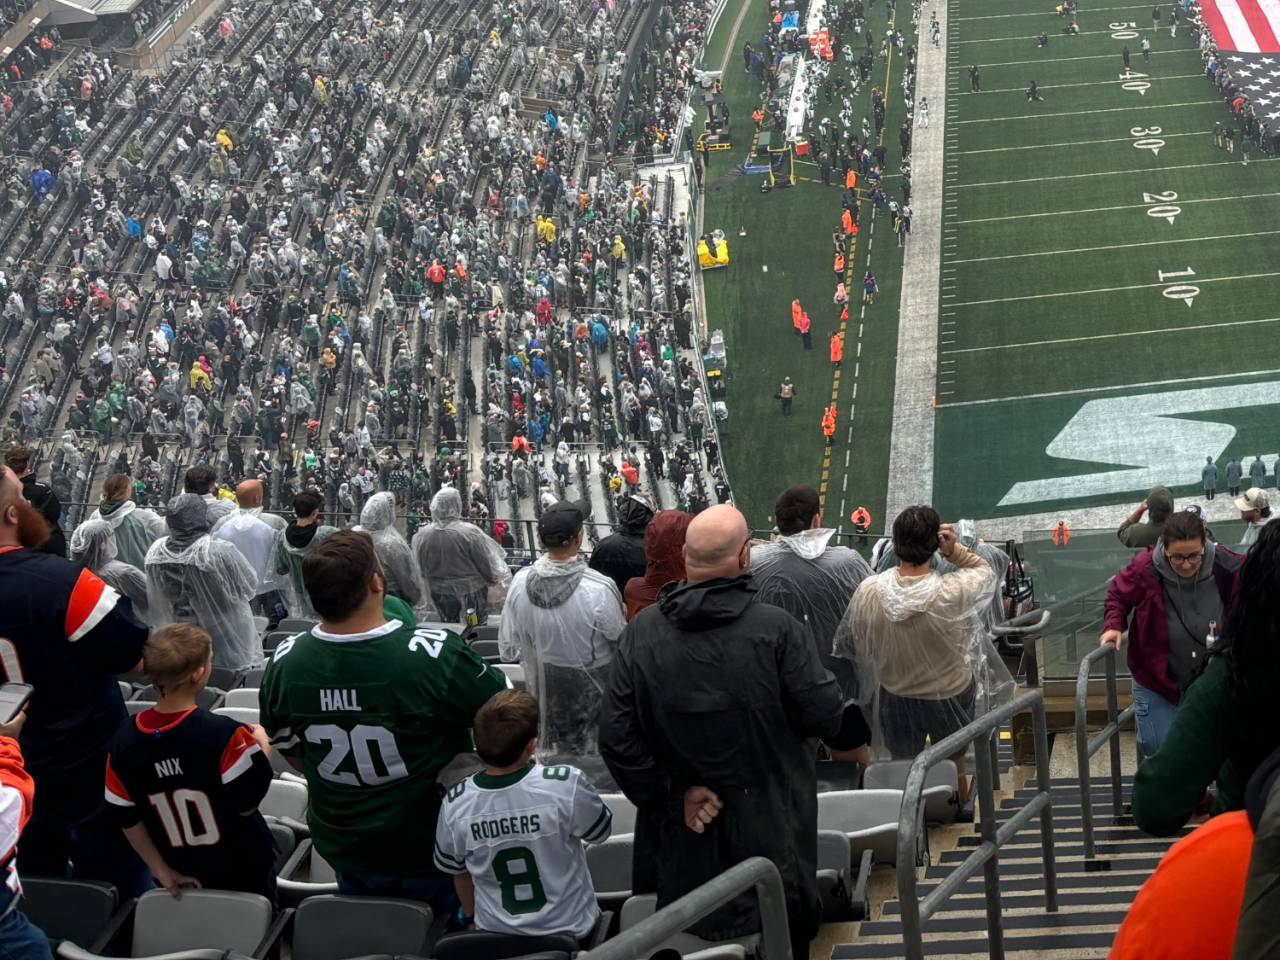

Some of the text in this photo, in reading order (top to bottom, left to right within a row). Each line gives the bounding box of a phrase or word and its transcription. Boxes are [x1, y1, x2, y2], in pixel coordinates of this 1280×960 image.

[1109, 21, 1139, 40] 50
[1118, 68, 1151, 90] 40
[1130, 125, 1165, 149] 30
[1143, 190, 1182, 218] 20
[1158, 266, 1200, 299] 10
[408, 627, 447, 659] 20
[319, 689, 362, 712] HALL
[154, 757, 184, 779] NIX
[303, 724, 409, 786] 20
[542, 764, 570, 782] 8
[149, 789, 220, 847] 10
[471, 814, 541, 841] RODGERS
[491, 846, 548, 916] 8
